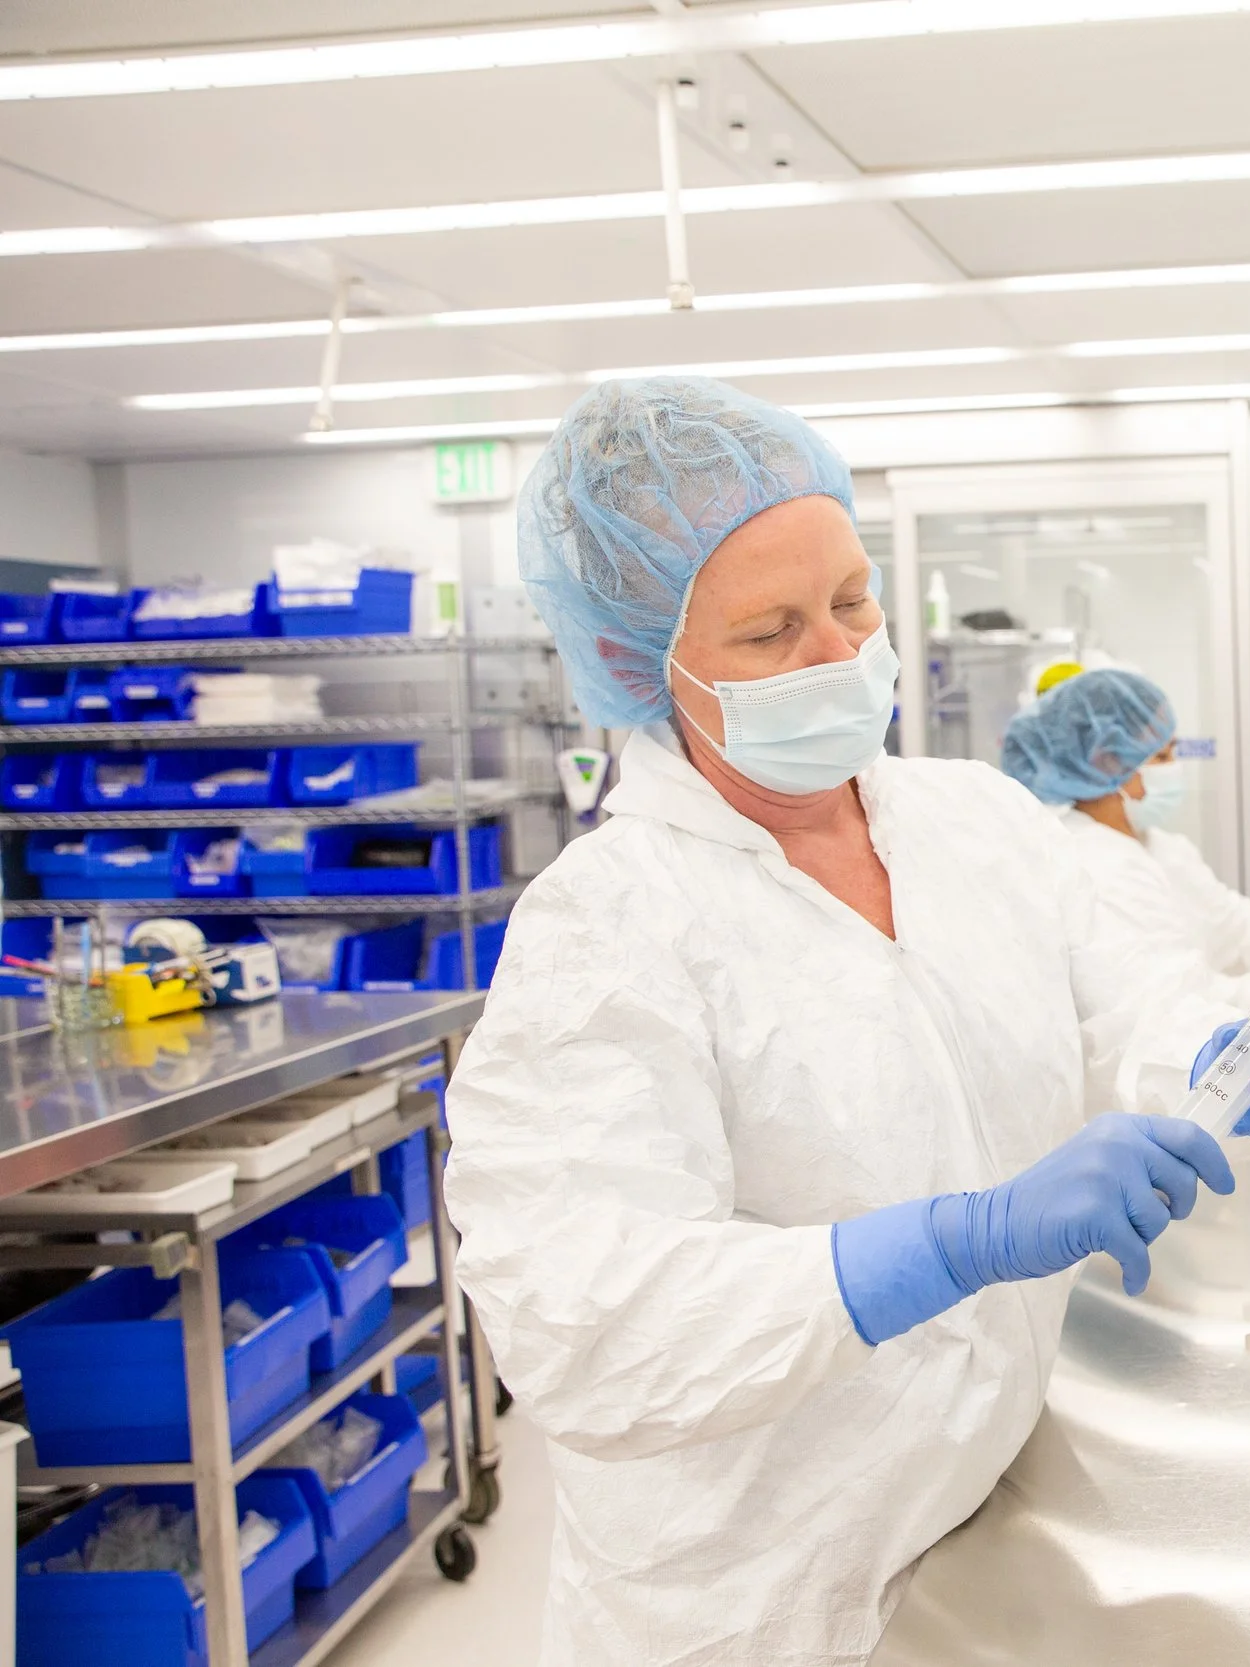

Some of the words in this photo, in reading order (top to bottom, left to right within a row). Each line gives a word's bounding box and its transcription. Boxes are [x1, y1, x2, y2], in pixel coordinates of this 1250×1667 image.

[436, 441, 496, 497] EXIT
[1236, 1044, 1249, 1054] 40
[1220, 1062, 1234, 1073] 50
[1204, 1081, 1229, 1101] 60cc
